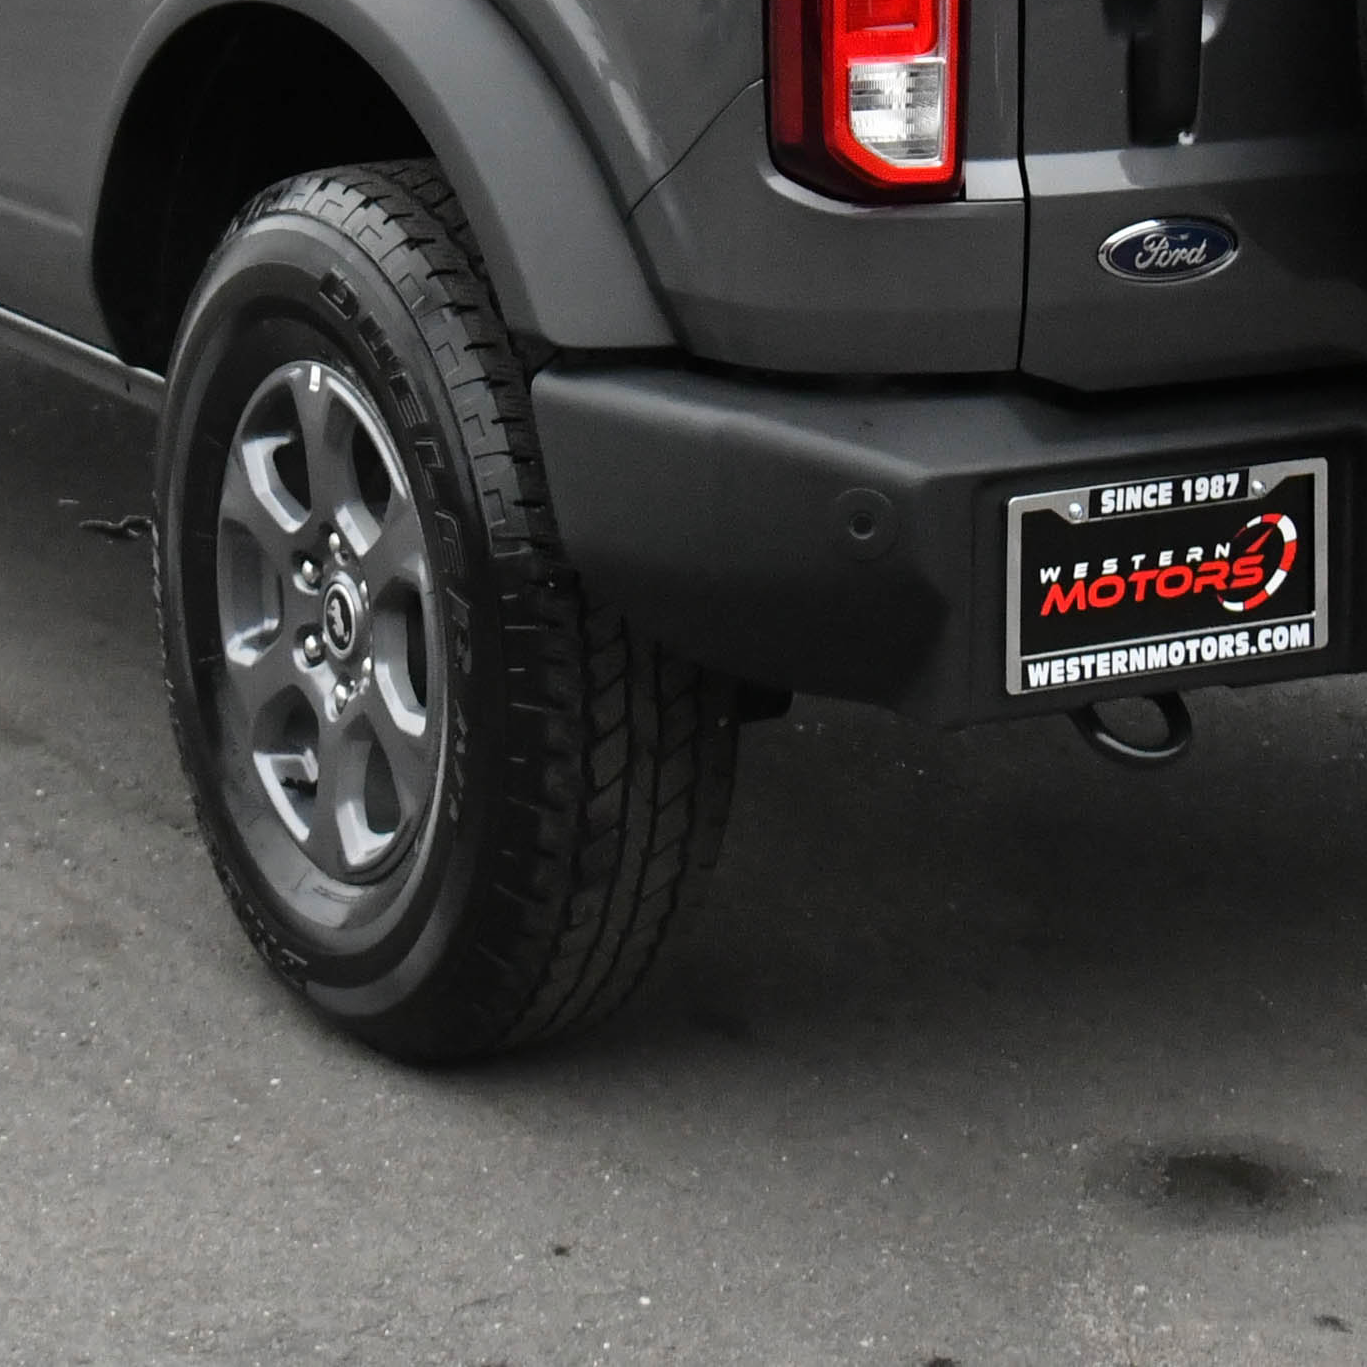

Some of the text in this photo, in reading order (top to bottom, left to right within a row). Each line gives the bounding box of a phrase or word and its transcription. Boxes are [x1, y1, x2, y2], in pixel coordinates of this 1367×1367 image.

[1135, 232, 1207, 270] Ford
[1100, 473, 1241, 515] SINCE 1987
[1039, 541, 1232, 585] WESTERN
[1039, 553, 1266, 617] MOTORS
[1027, 621, 1312, 688] WESTERNMOTORS.COM
